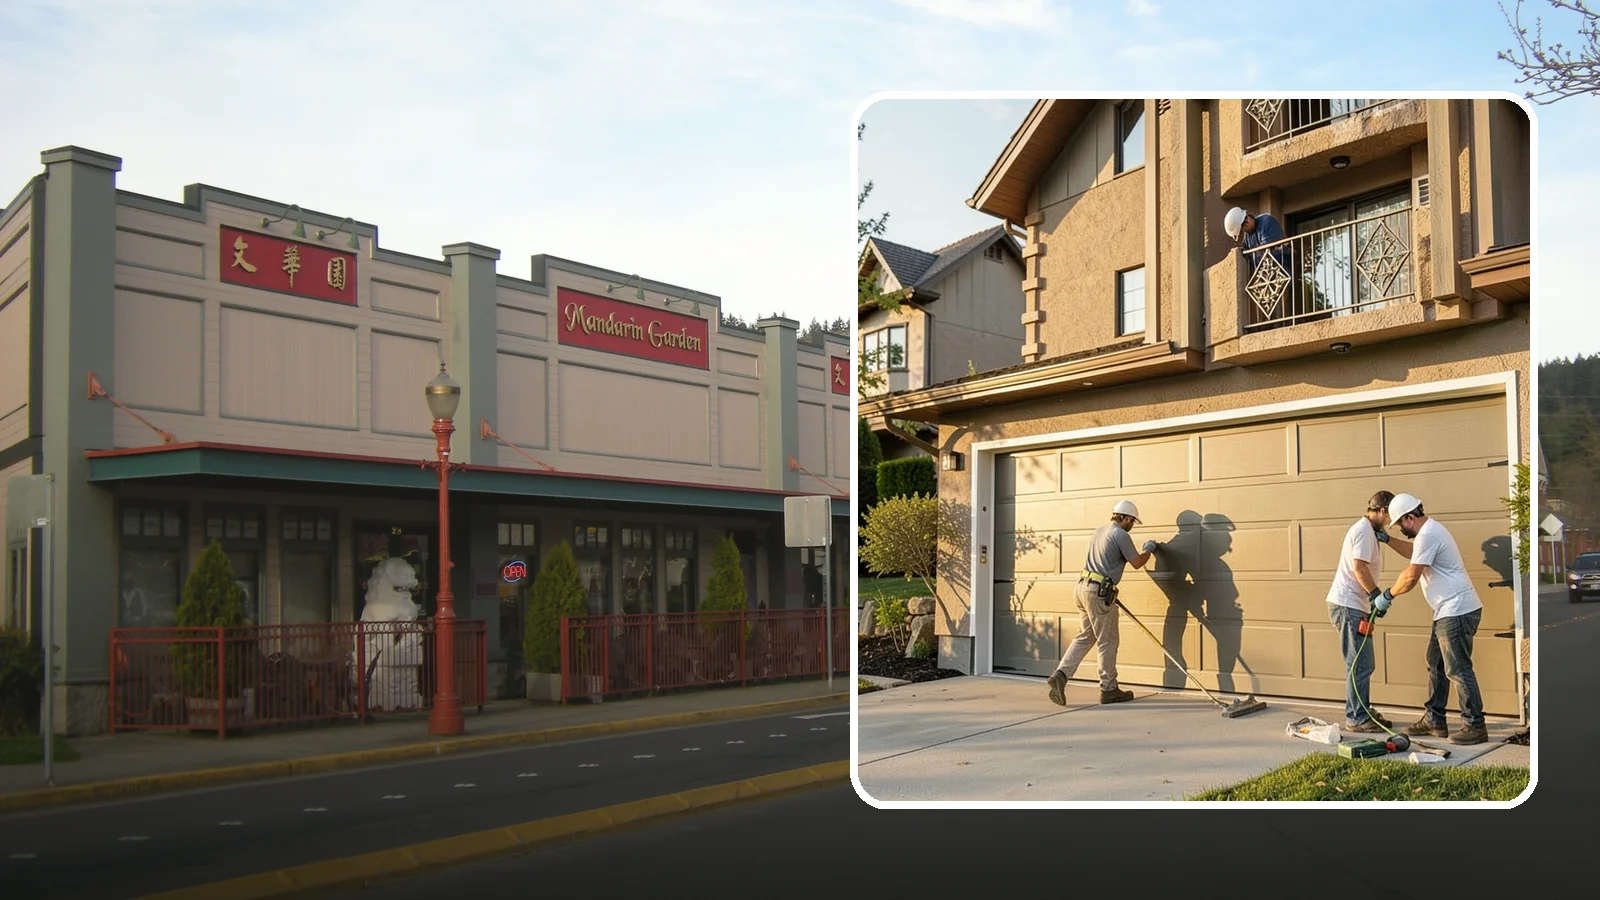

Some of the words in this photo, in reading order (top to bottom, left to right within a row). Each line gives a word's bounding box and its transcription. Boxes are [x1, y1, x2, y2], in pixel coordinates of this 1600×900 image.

[231, 235, 346, 291] 文華園
[564, 302, 644, 341] Mandarin
[647, 319, 702, 352] Garden
[503, 565, 527, 578] OPEN
